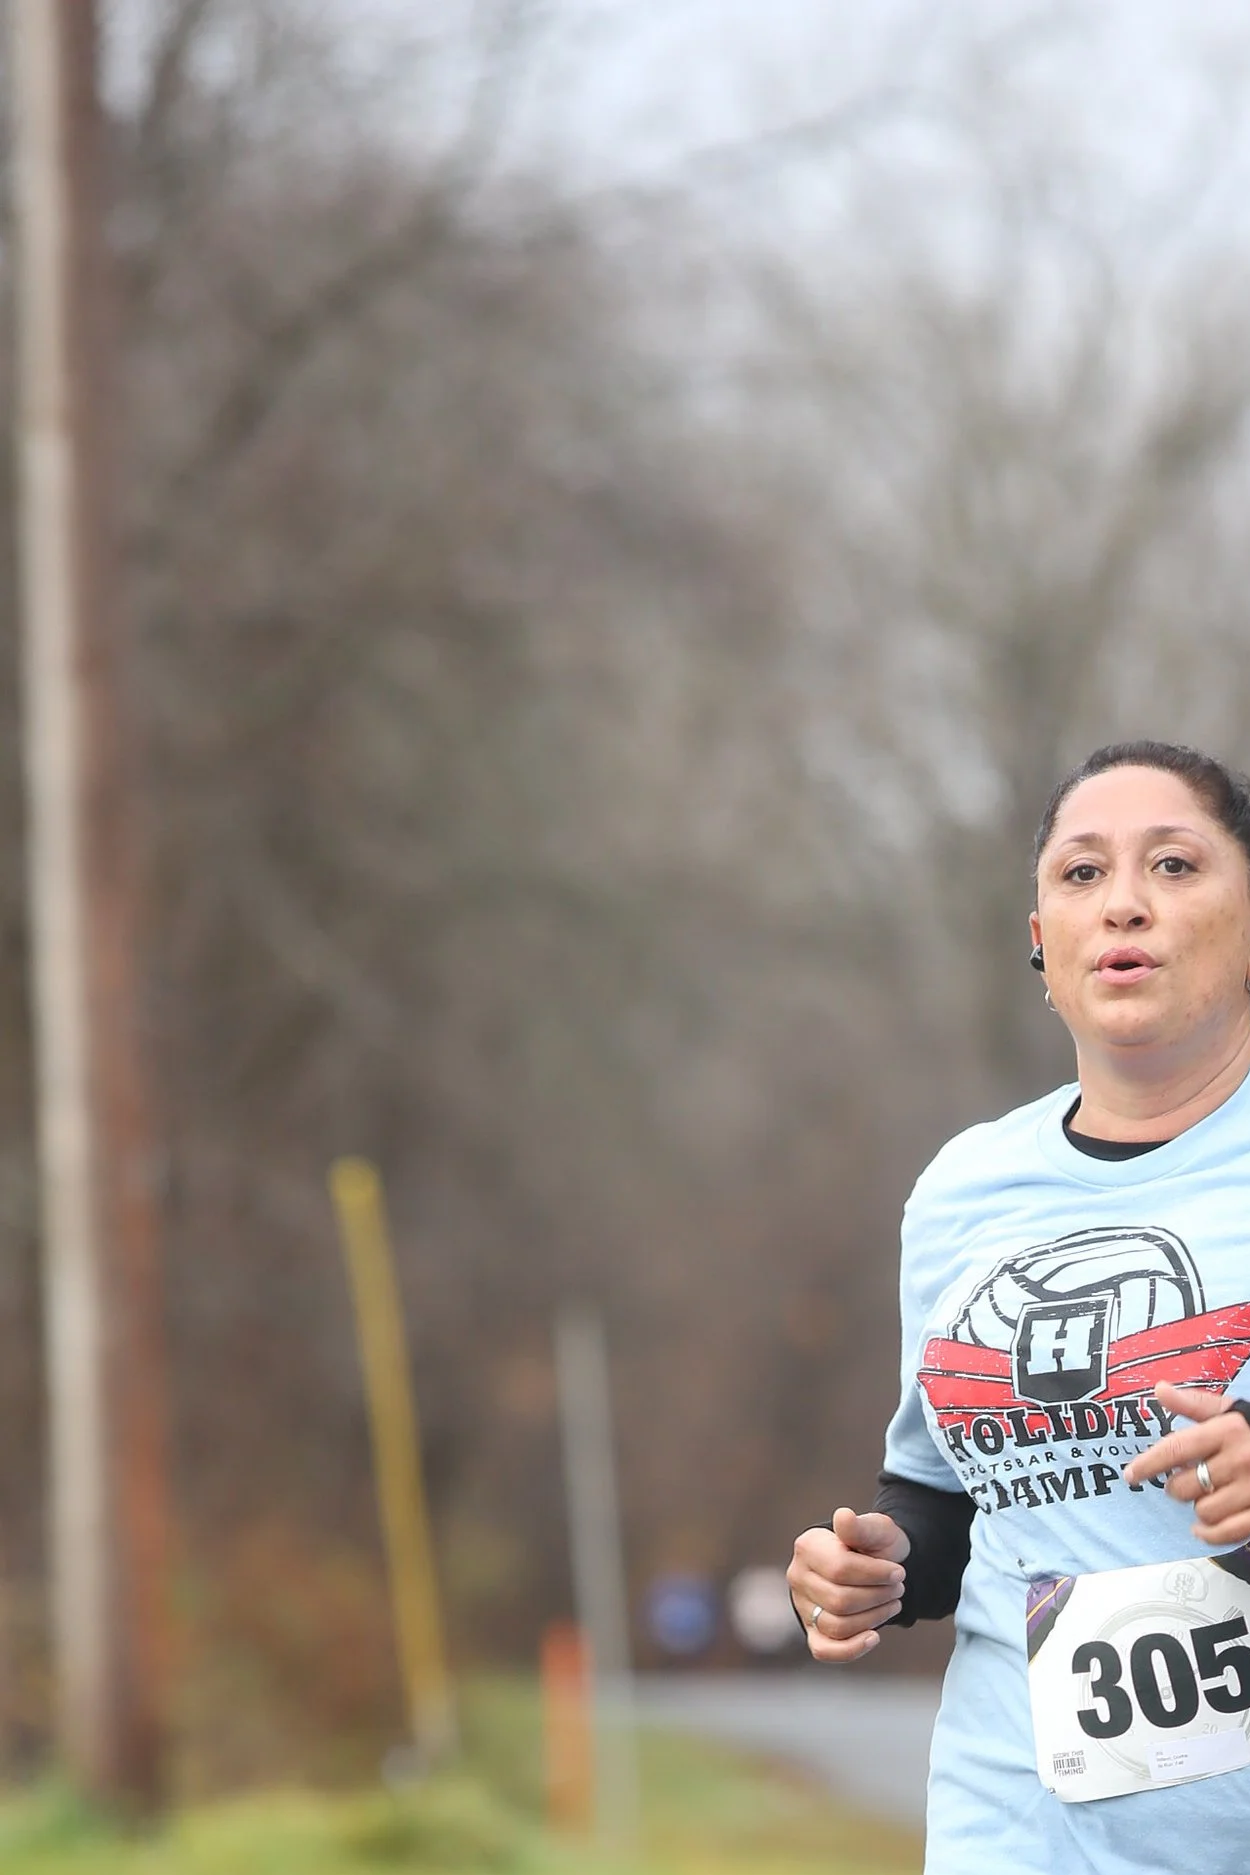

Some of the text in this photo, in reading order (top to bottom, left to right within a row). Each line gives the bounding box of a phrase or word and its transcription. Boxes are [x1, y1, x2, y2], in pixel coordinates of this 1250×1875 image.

[1026, 1314, 1096, 1376] H
[943, 1398, 1178, 1463] HOLIDAY
[961, 1450, 1057, 1481] SPOTSBAR
[1070, 1446, 1085, 1459] &
[1057, 1766, 1084, 1778] TIMING
